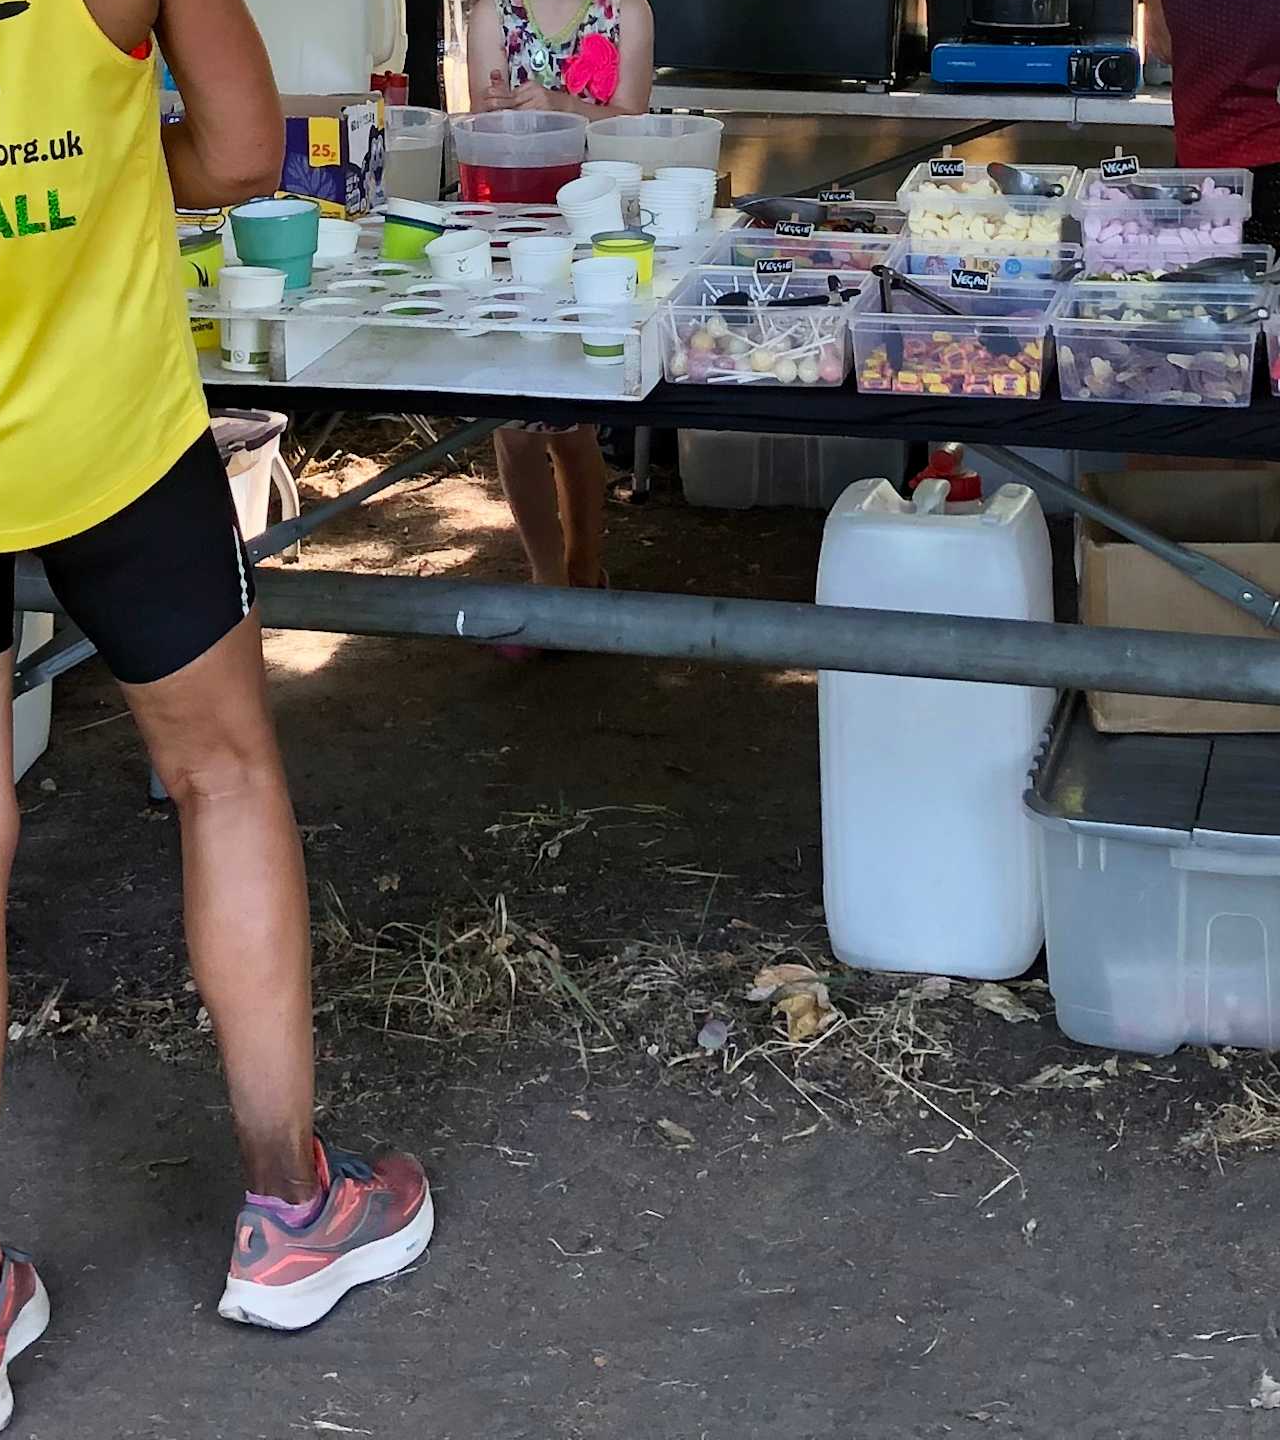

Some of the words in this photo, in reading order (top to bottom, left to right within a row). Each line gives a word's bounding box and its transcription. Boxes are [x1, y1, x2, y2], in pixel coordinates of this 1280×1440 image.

[931, 162, 964, 174] VEGGIE
[1103, 161, 1135, 175] VEGAN
[758, 260, 793, 272] VEGGIE
[952, 271, 988, 287] VEGAN
